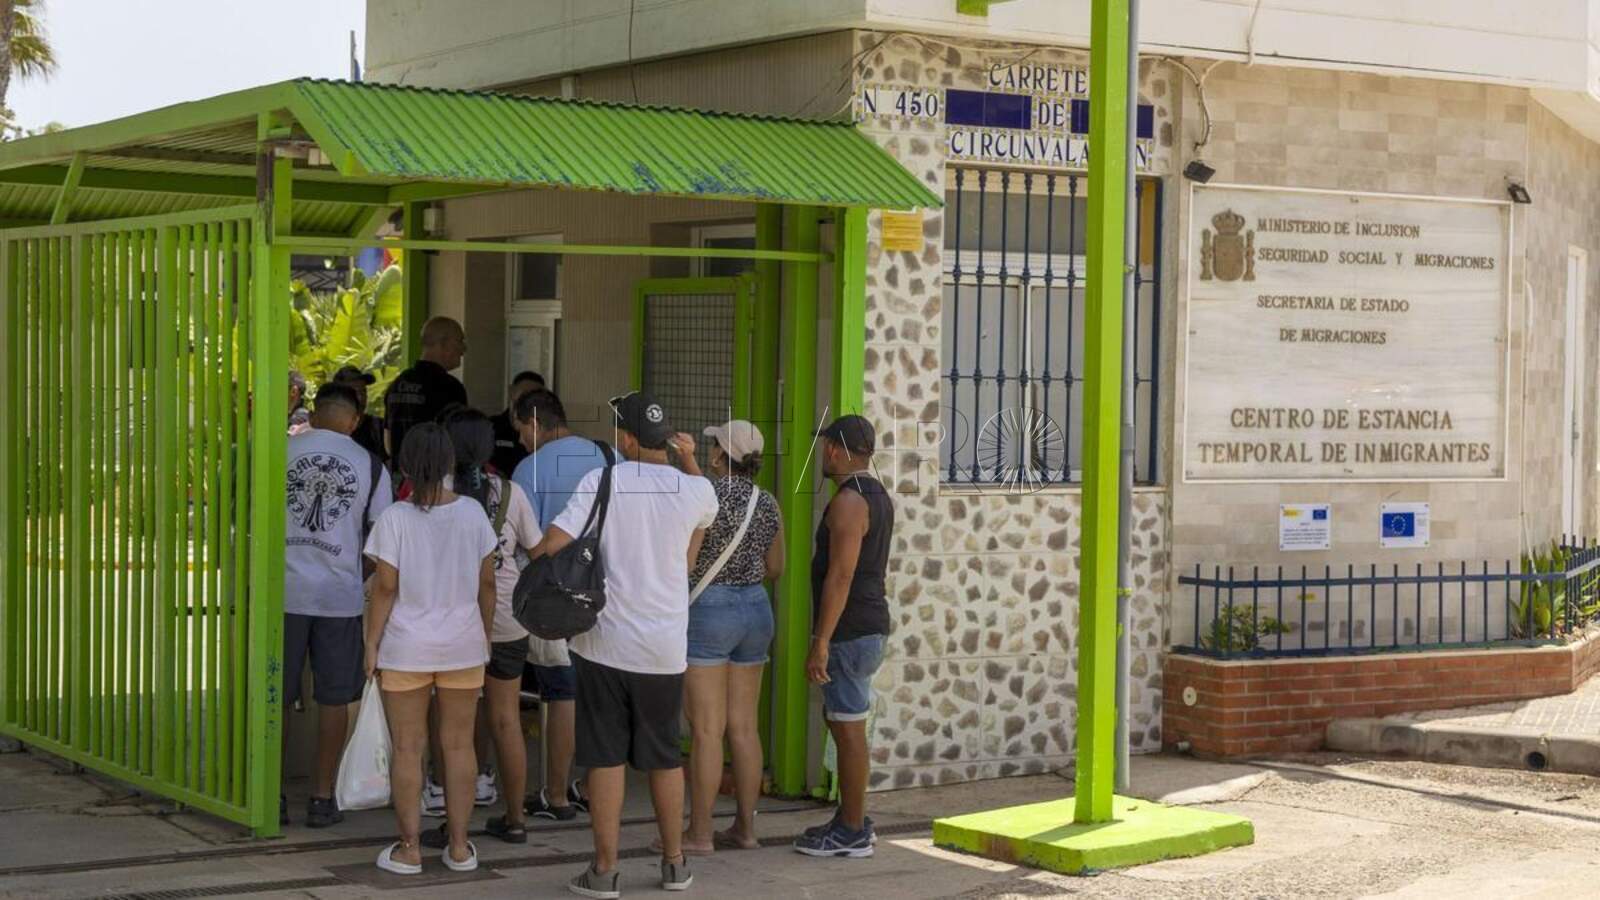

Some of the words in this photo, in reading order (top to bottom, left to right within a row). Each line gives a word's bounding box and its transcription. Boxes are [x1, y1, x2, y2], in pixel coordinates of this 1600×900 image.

[989, 63, 1087, 94] CARRETE
[863, 88, 877, 113] N
[895, 91, 938, 117] 450
[1038, 101, 1065, 127] DE
[951, 130, 1147, 167] CIRCUNVALAN
[1257, 217, 1331, 234] MINISTERIO
[1334, 220, 1350, 235] DE
[1356, 221, 1420, 239] INCLUSION
[1258, 247, 1329, 264] SEGURIDAD
[1338, 250, 1387, 265] SOCIAL
[1395, 252, 1403, 265] Y
[1414, 254, 1495, 270] MIGRACIONES
[1257, 295, 1335, 311] SECRETARIA
[1340, 297, 1357, 311] DE
[1361, 298, 1409, 313] ESTADO
[1279, 328, 1297, 343] DE
[1301, 328, 1387, 345] MIGRACIONES
[1230, 407, 1315, 430] CENTRO
[1323, 408, 1349, 430] DE
[1358, 409, 1453, 431] ESTANCIA
[1198, 442, 1313, 463] TEMPORAL
[1321, 442, 1347, 463] DE
[1355, 442, 1491, 463] INMIGRANTES
